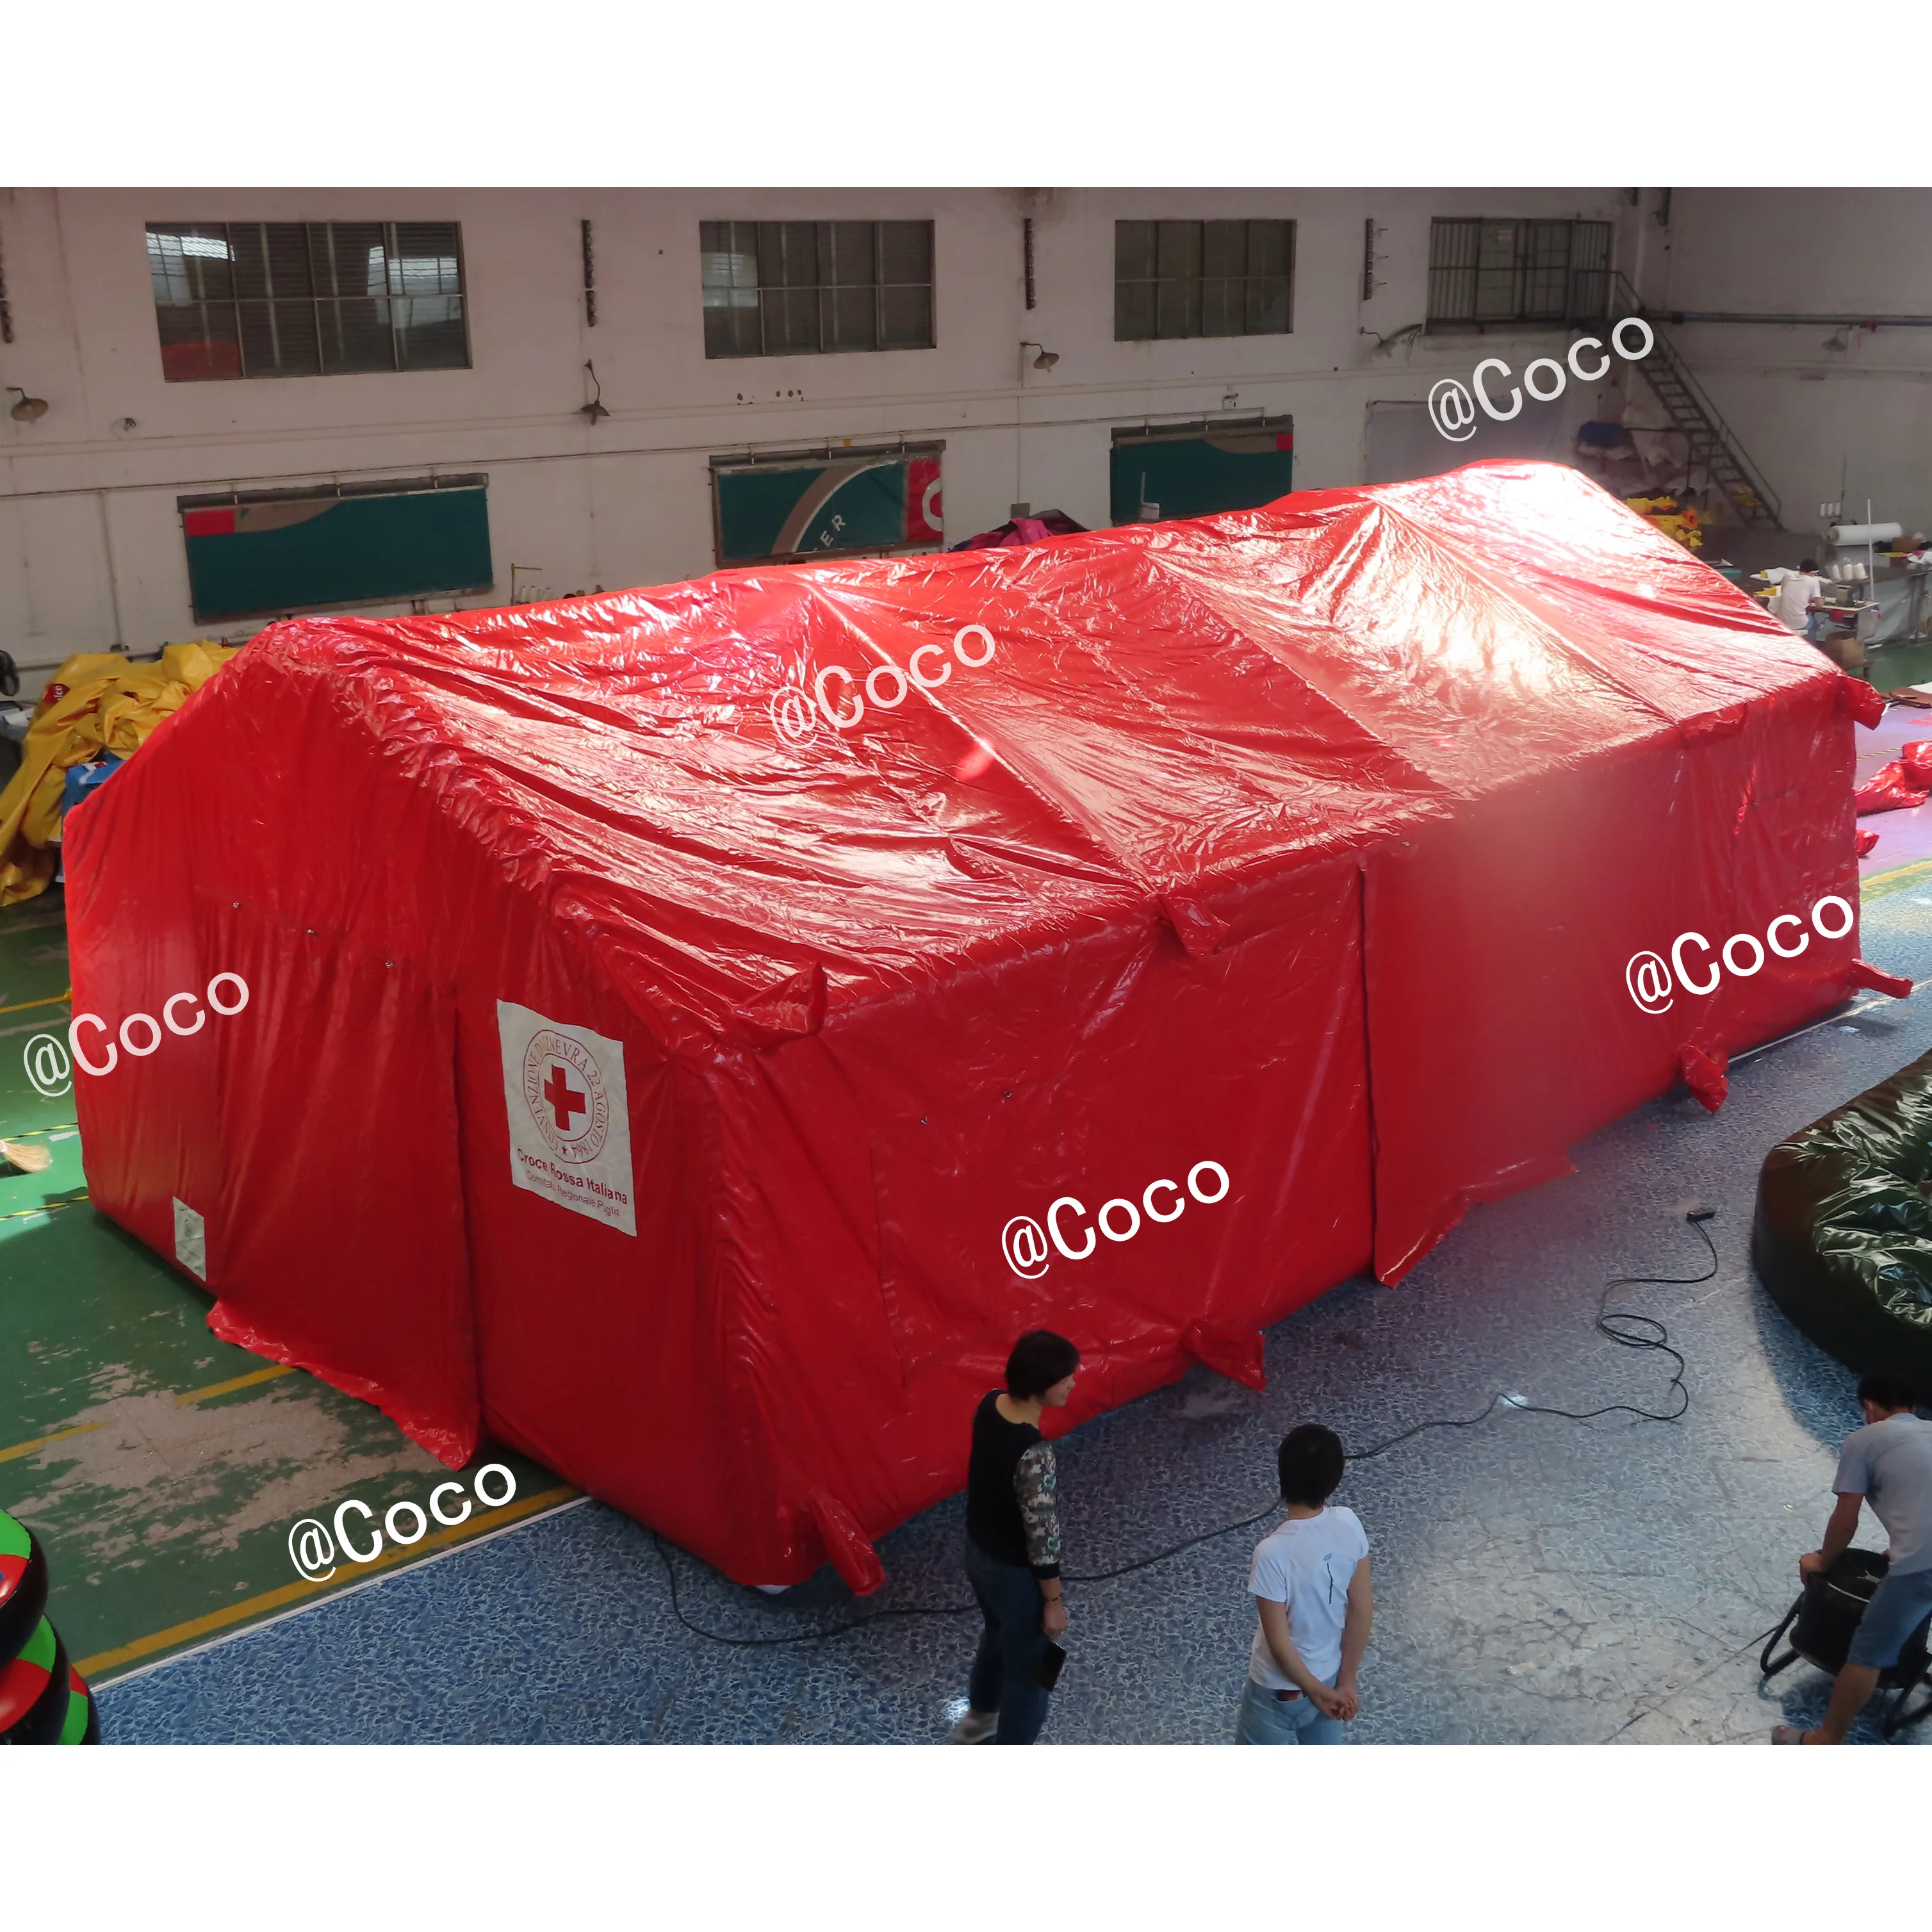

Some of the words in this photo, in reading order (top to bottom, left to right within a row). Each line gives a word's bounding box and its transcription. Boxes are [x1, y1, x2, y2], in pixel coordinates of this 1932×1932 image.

[814, 514, 846, 550] ER
[587, 1070, 601, 1087] 22
[589, 1091, 606, 1147] AGOSTO
[571, 1140, 593, 1158] 1864
[517, 1148, 548, 1172] Croce
[550, 1162, 584, 1188] Rossa
[587, 1177, 628, 1205] Italiana
[557, 1185, 596, 1208] Regionale
[597, 1199, 620, 1217] Pglia
